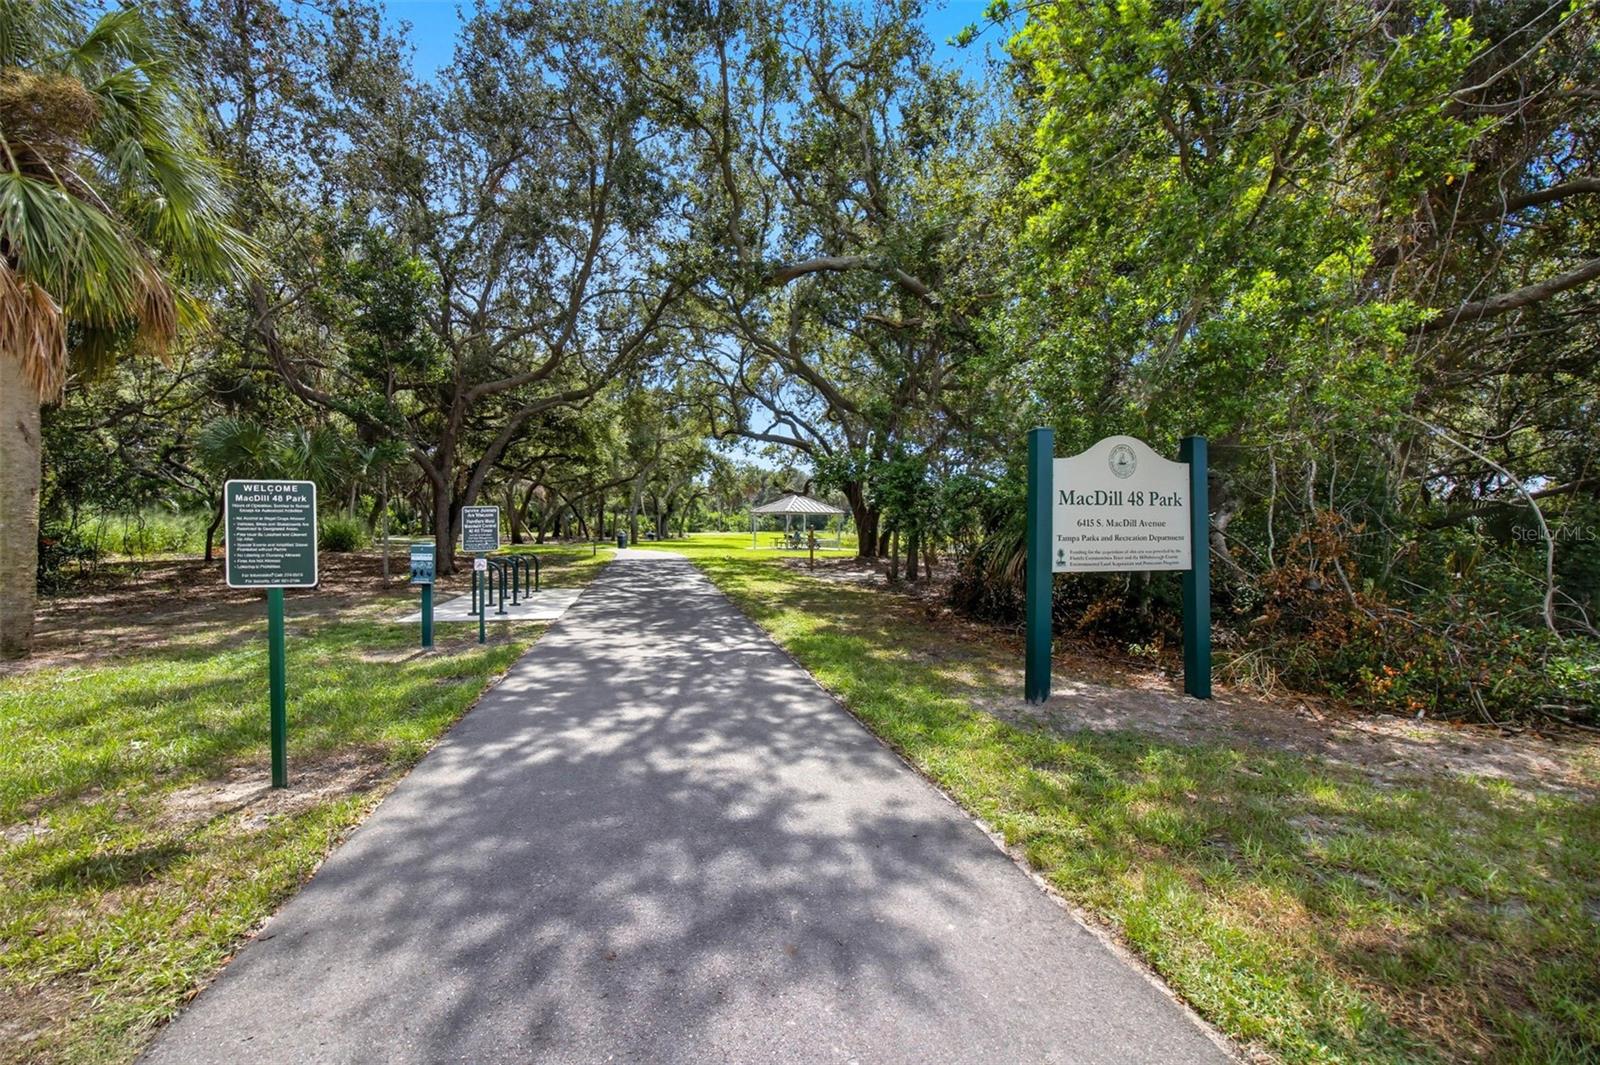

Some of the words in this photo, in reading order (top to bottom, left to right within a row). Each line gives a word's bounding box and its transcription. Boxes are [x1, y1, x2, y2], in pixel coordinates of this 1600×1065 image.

[1059, 490, 1123, 506] MacDill
[1128, 491, 1144, 506] 48
[1149, 492, 1183, 507] Park
[1077, 519, 1094, 527] 6415
[1096, 519, 1103, 527] S.
[1106, 519, 1137, 527] MacDill
[1139, 519, 1166, 527] Avenue
